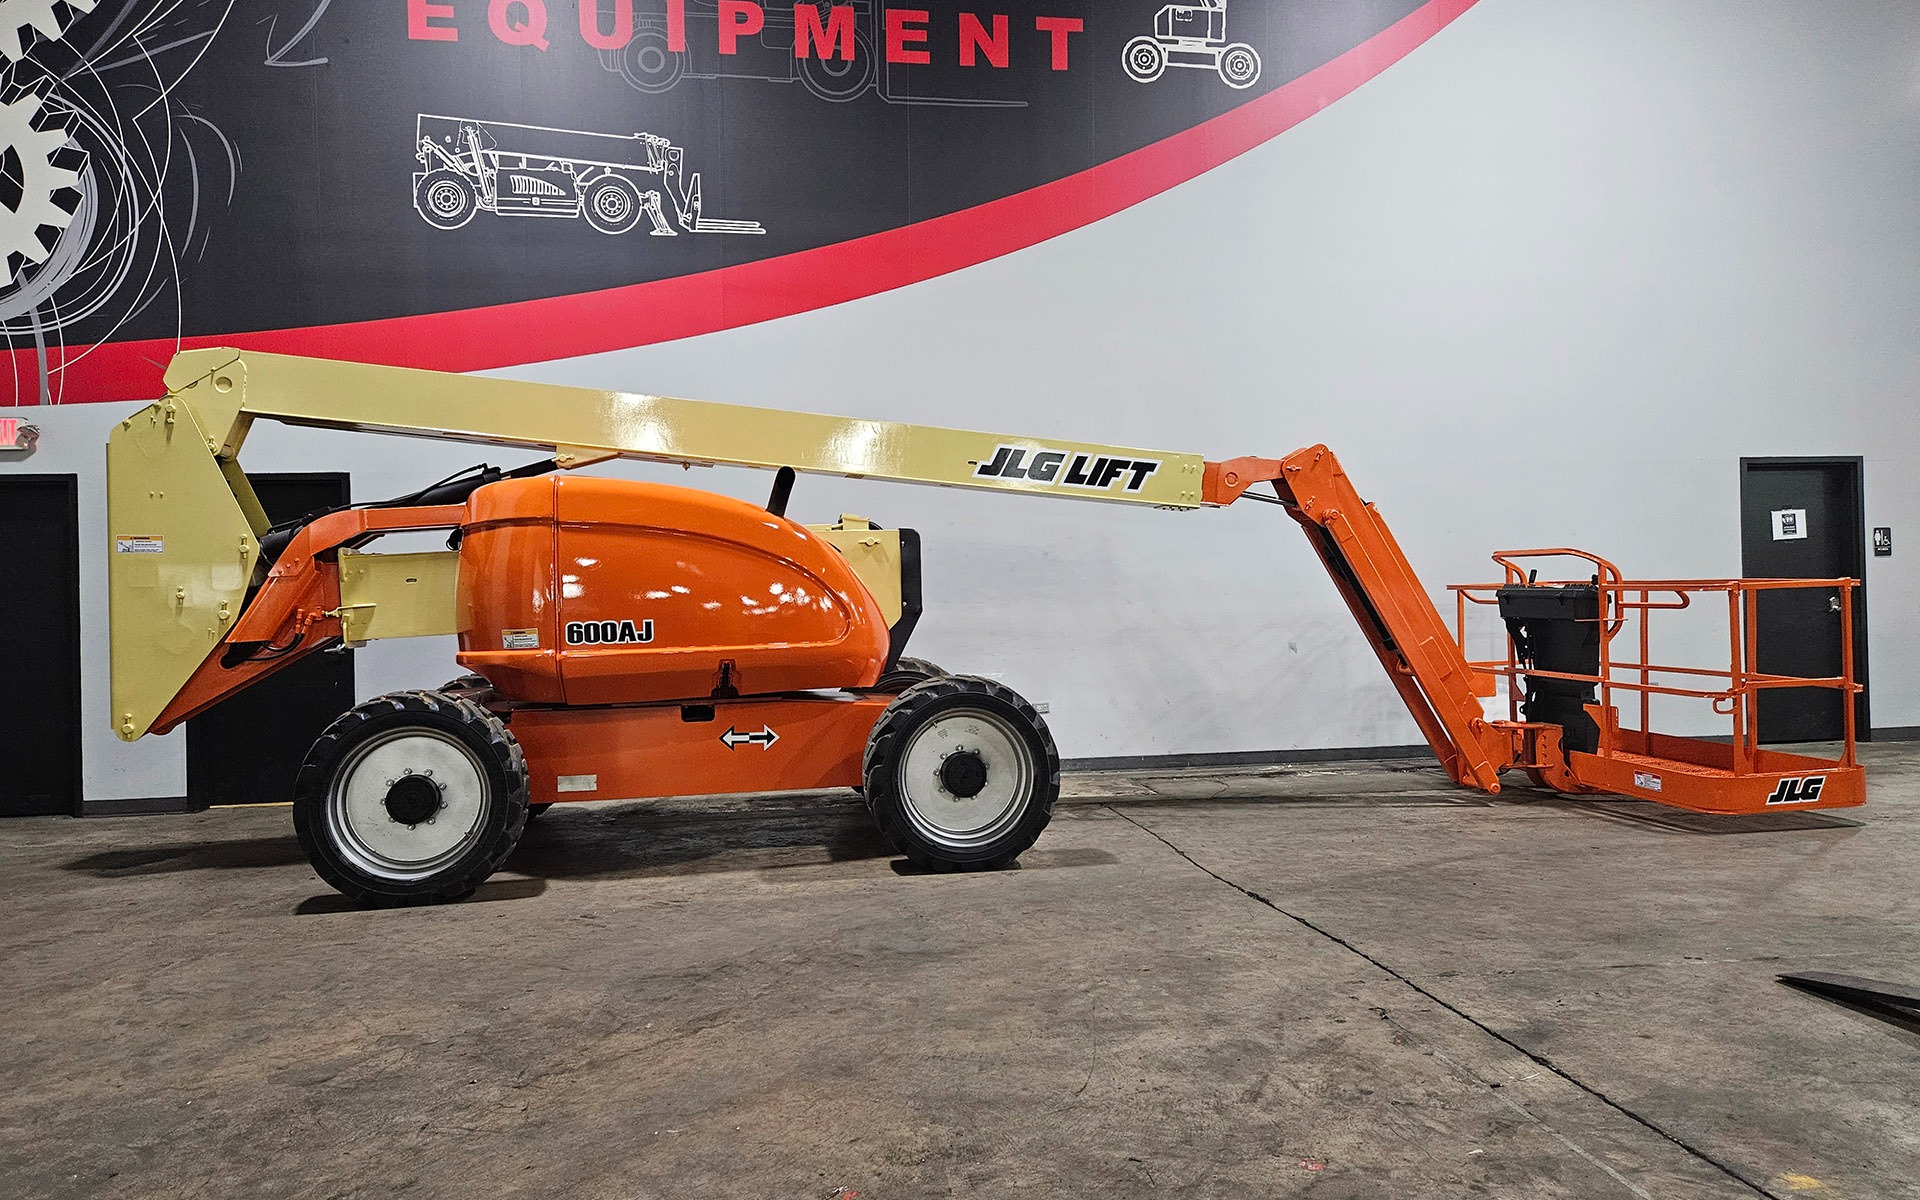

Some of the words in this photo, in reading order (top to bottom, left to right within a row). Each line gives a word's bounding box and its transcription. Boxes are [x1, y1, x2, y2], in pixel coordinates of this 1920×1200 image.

[407, 0, 1084, 71] EQUIPMENT
[0, 419, 17, 446] IT
[977, 447, 1067, 482] JLG
[1063, 454, 1159, 491] LIFT
[566, 620, 653, 644] 600AJ
[1767, 776, 1825, 804] JLG
